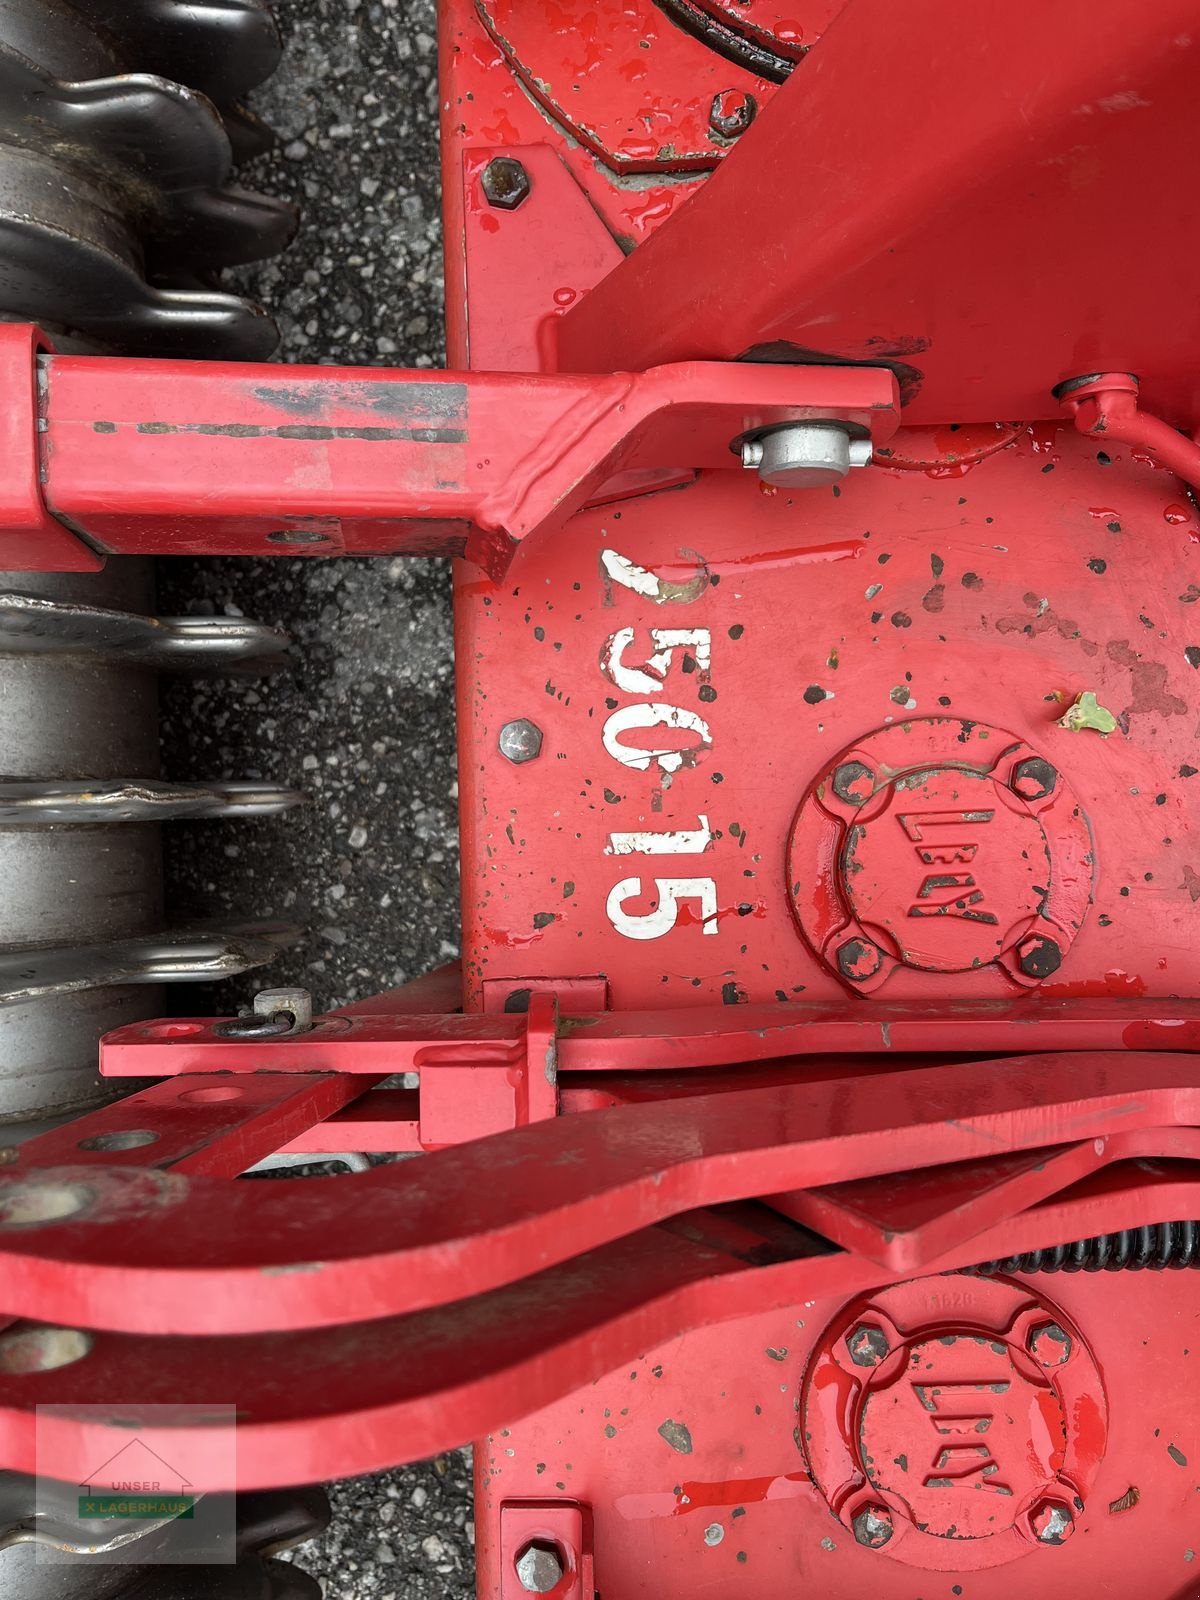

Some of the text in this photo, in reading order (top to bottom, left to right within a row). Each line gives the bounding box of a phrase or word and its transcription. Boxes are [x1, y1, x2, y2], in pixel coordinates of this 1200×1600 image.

[599, 546, 718, 940] 250-15
[895, 808, 999, 925] LELY
[911, 1379, 1014, 1496] LELY
